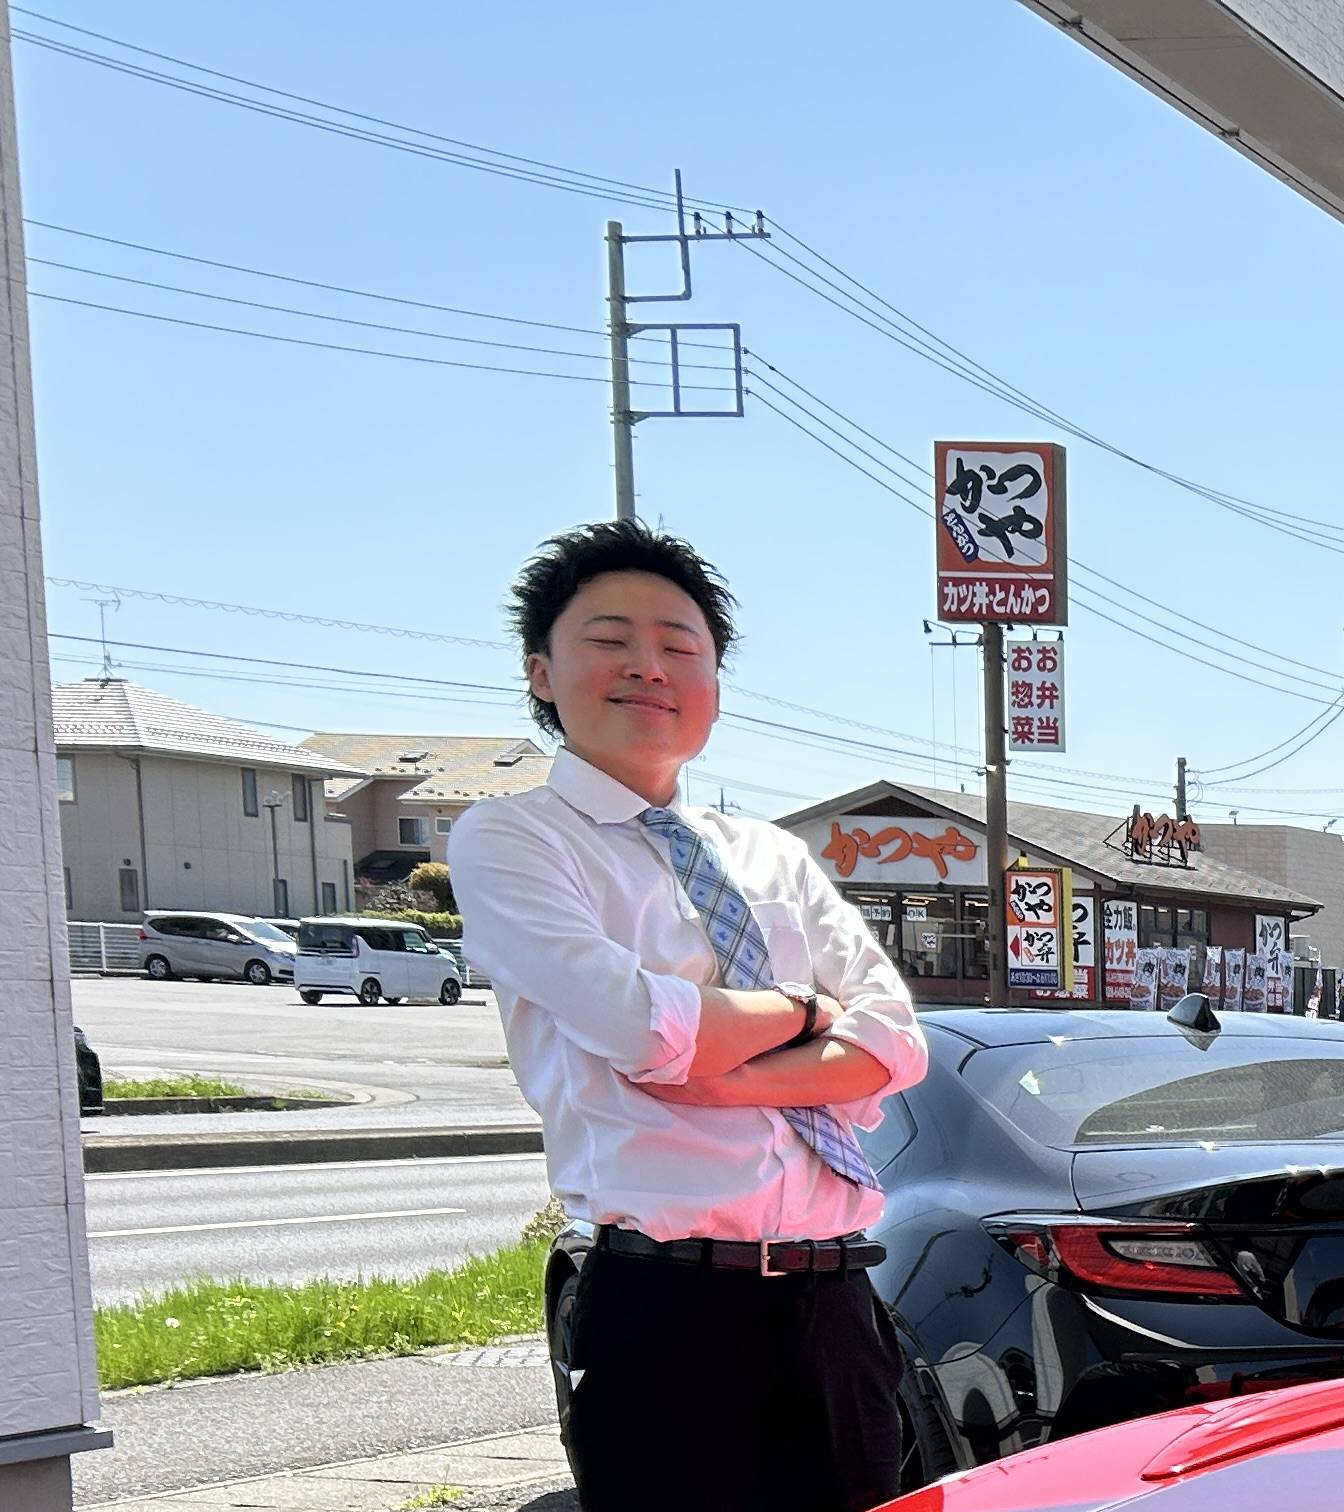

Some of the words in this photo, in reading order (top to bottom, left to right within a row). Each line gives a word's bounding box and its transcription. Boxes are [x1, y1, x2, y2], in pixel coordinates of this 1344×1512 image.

[946, 457, 1043, 558] かつや
[1011, 645, 1035, 744] お惣菜
[1036, 646, 1059, 745] お弁当
[821, 822, 977, 878] かつや
